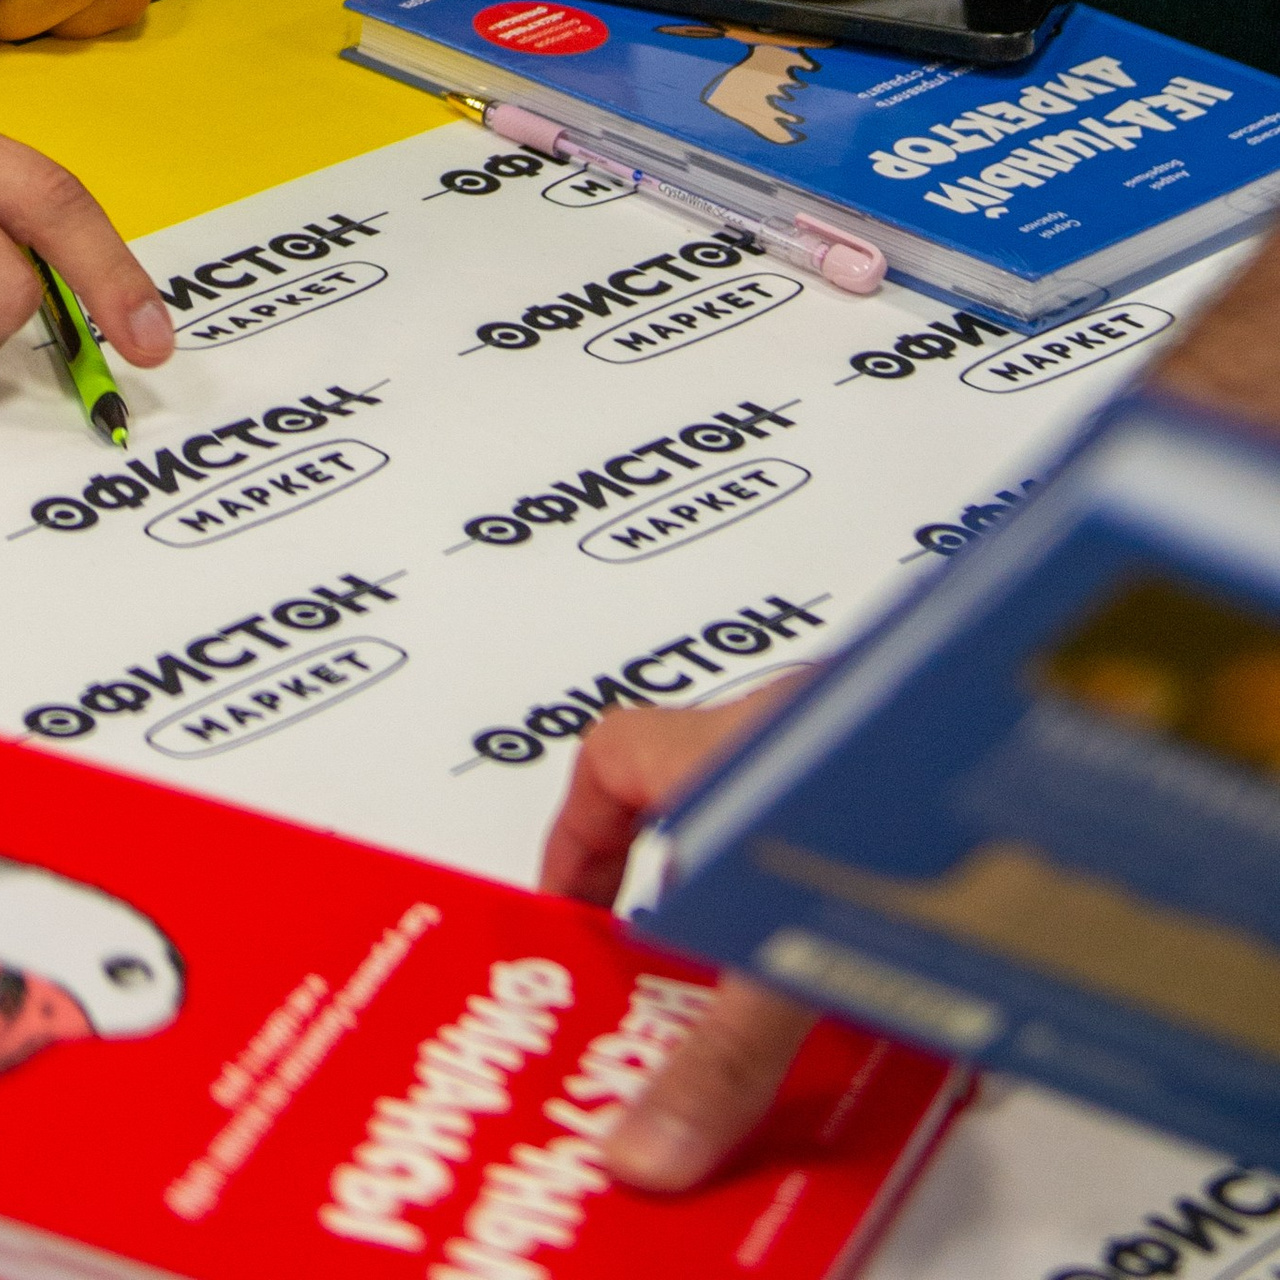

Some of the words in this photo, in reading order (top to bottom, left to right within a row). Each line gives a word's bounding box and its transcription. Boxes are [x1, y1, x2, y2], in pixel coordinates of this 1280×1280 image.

[867, 55, 1138, 180] ДИРЕКТОР
[923, 76, 1235, 220] НЕДУШНЫЙ
[125, 212, 382, 325] ИСТОН
[191, 269, 359, 341] МАРКЕТ
[612, 278, 776, 354] МАРКЕТ
[987, 310, 1158, 384] МАРКЕТ
[30, 384, 382, 533] ОФИСТОН
[177, 448, 358, 537] МАРКЕТ
[463, 400, 797, 547] ОФИСТОН
[611, 466, 781, 554] МАРКЕТ
[23, 574, 399, 738] ОФИСТОН
[181, 650, 373, 743] МАРКЕТ
[471, 594, 829, 765] ОФИСТОН
[321, 957, 573, 1254] ФИНАНСЫ
